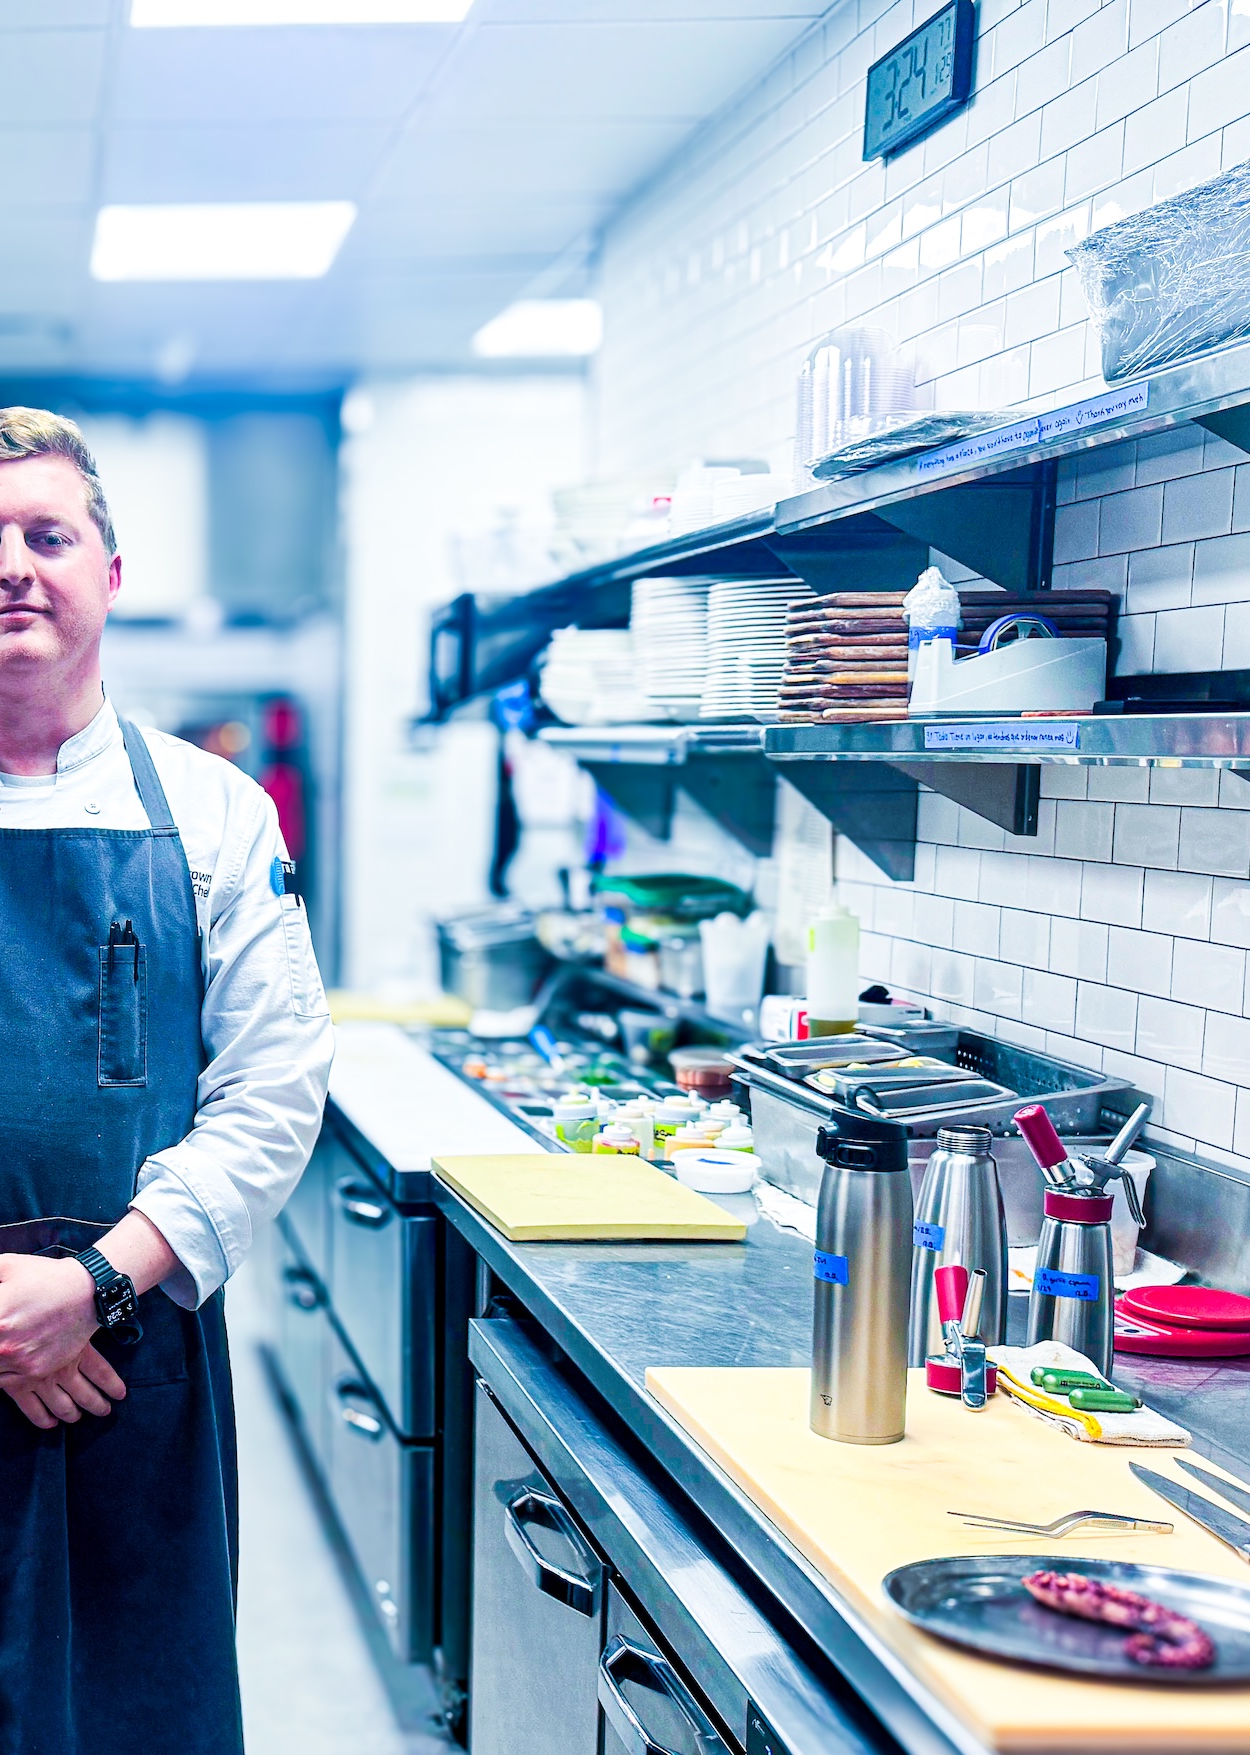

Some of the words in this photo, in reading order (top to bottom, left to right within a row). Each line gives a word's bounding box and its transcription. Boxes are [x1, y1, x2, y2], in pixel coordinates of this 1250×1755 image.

[882, 37, 929, 132] 3:24
[1055, 417, 1070, 431] again
[1085, 407, 1105, 419] Thank
[1128, 393, 1144, 406] much
